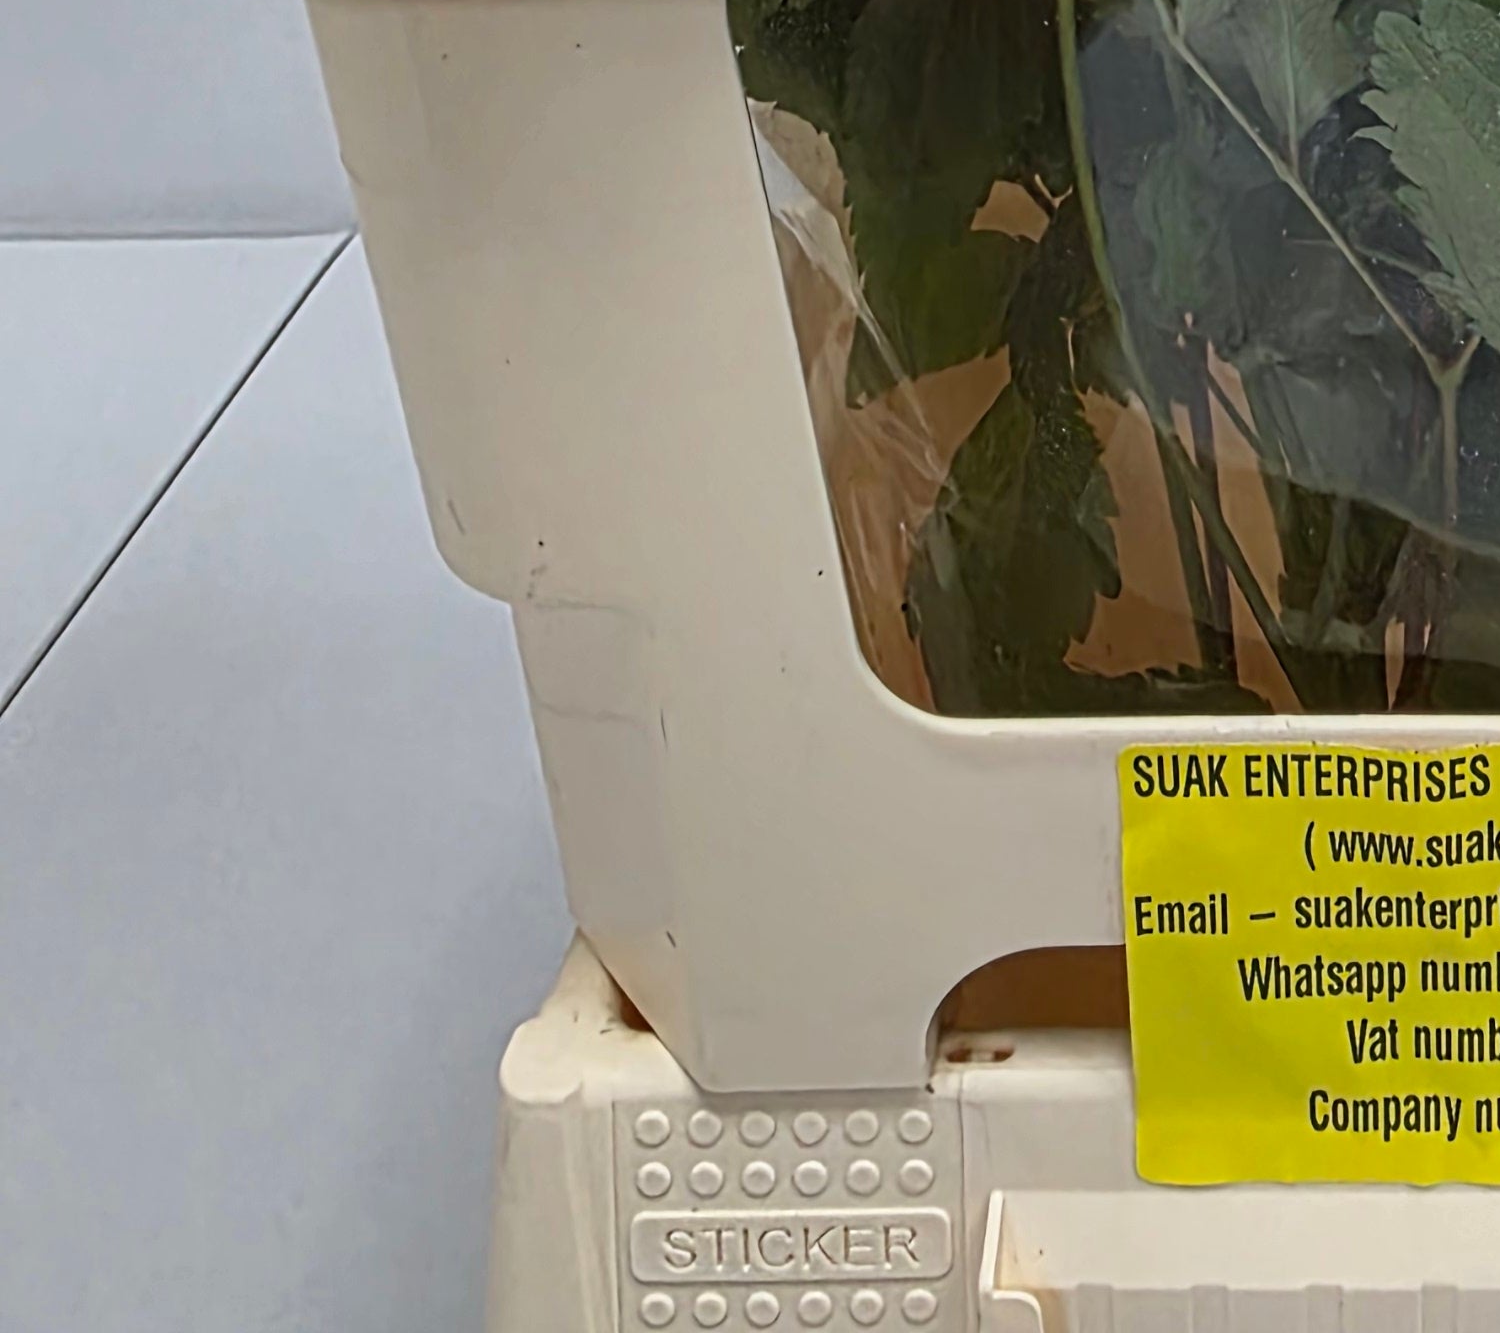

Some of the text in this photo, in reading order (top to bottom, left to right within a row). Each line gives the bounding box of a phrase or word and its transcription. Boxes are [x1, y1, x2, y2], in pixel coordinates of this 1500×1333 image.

[1134, 755, 1228, 797] SUAK
[1245, 754, 1490, 802] ENTERPRISES
[1135, 893, 1227, 936] Email
[1238, 956, 1405, 1002] Whatsapp
[1347, 1018, 1398, 1063] Vat
[1310, 1090, 1461, 1142] Company
[664, 1224, 920, 1270] STICKER
